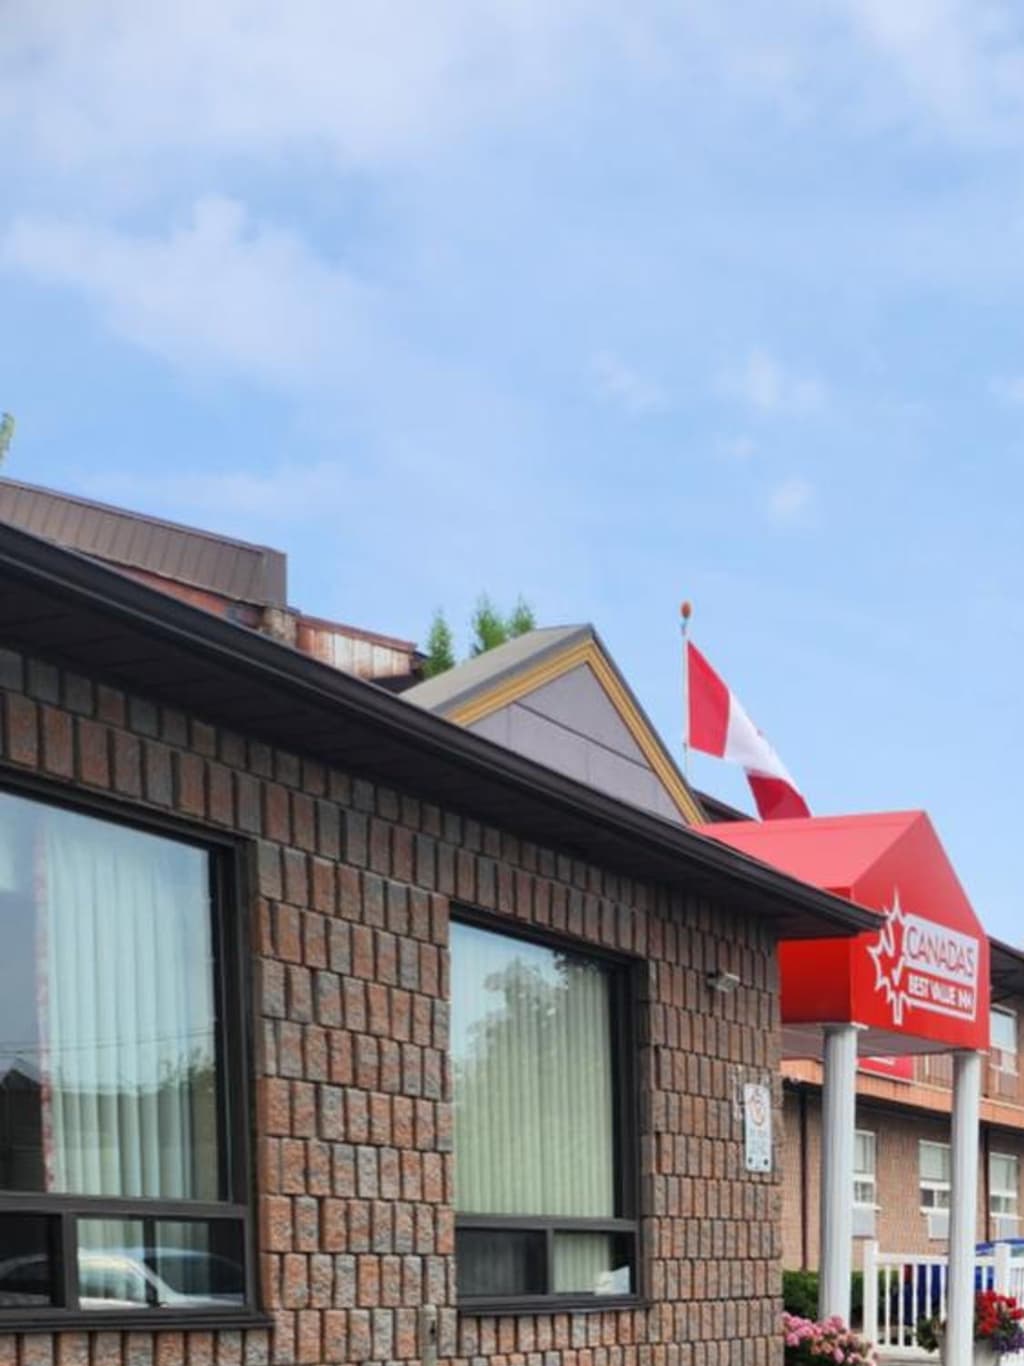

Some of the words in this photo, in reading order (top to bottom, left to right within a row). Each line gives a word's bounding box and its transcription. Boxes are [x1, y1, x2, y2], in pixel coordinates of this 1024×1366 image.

[906, 925, 974, 977] CANADAS
[908, 974, 930, 997] BEST
[930, 980, 956, 1005] VALUE
[958, 988, 974, 1009] INN
